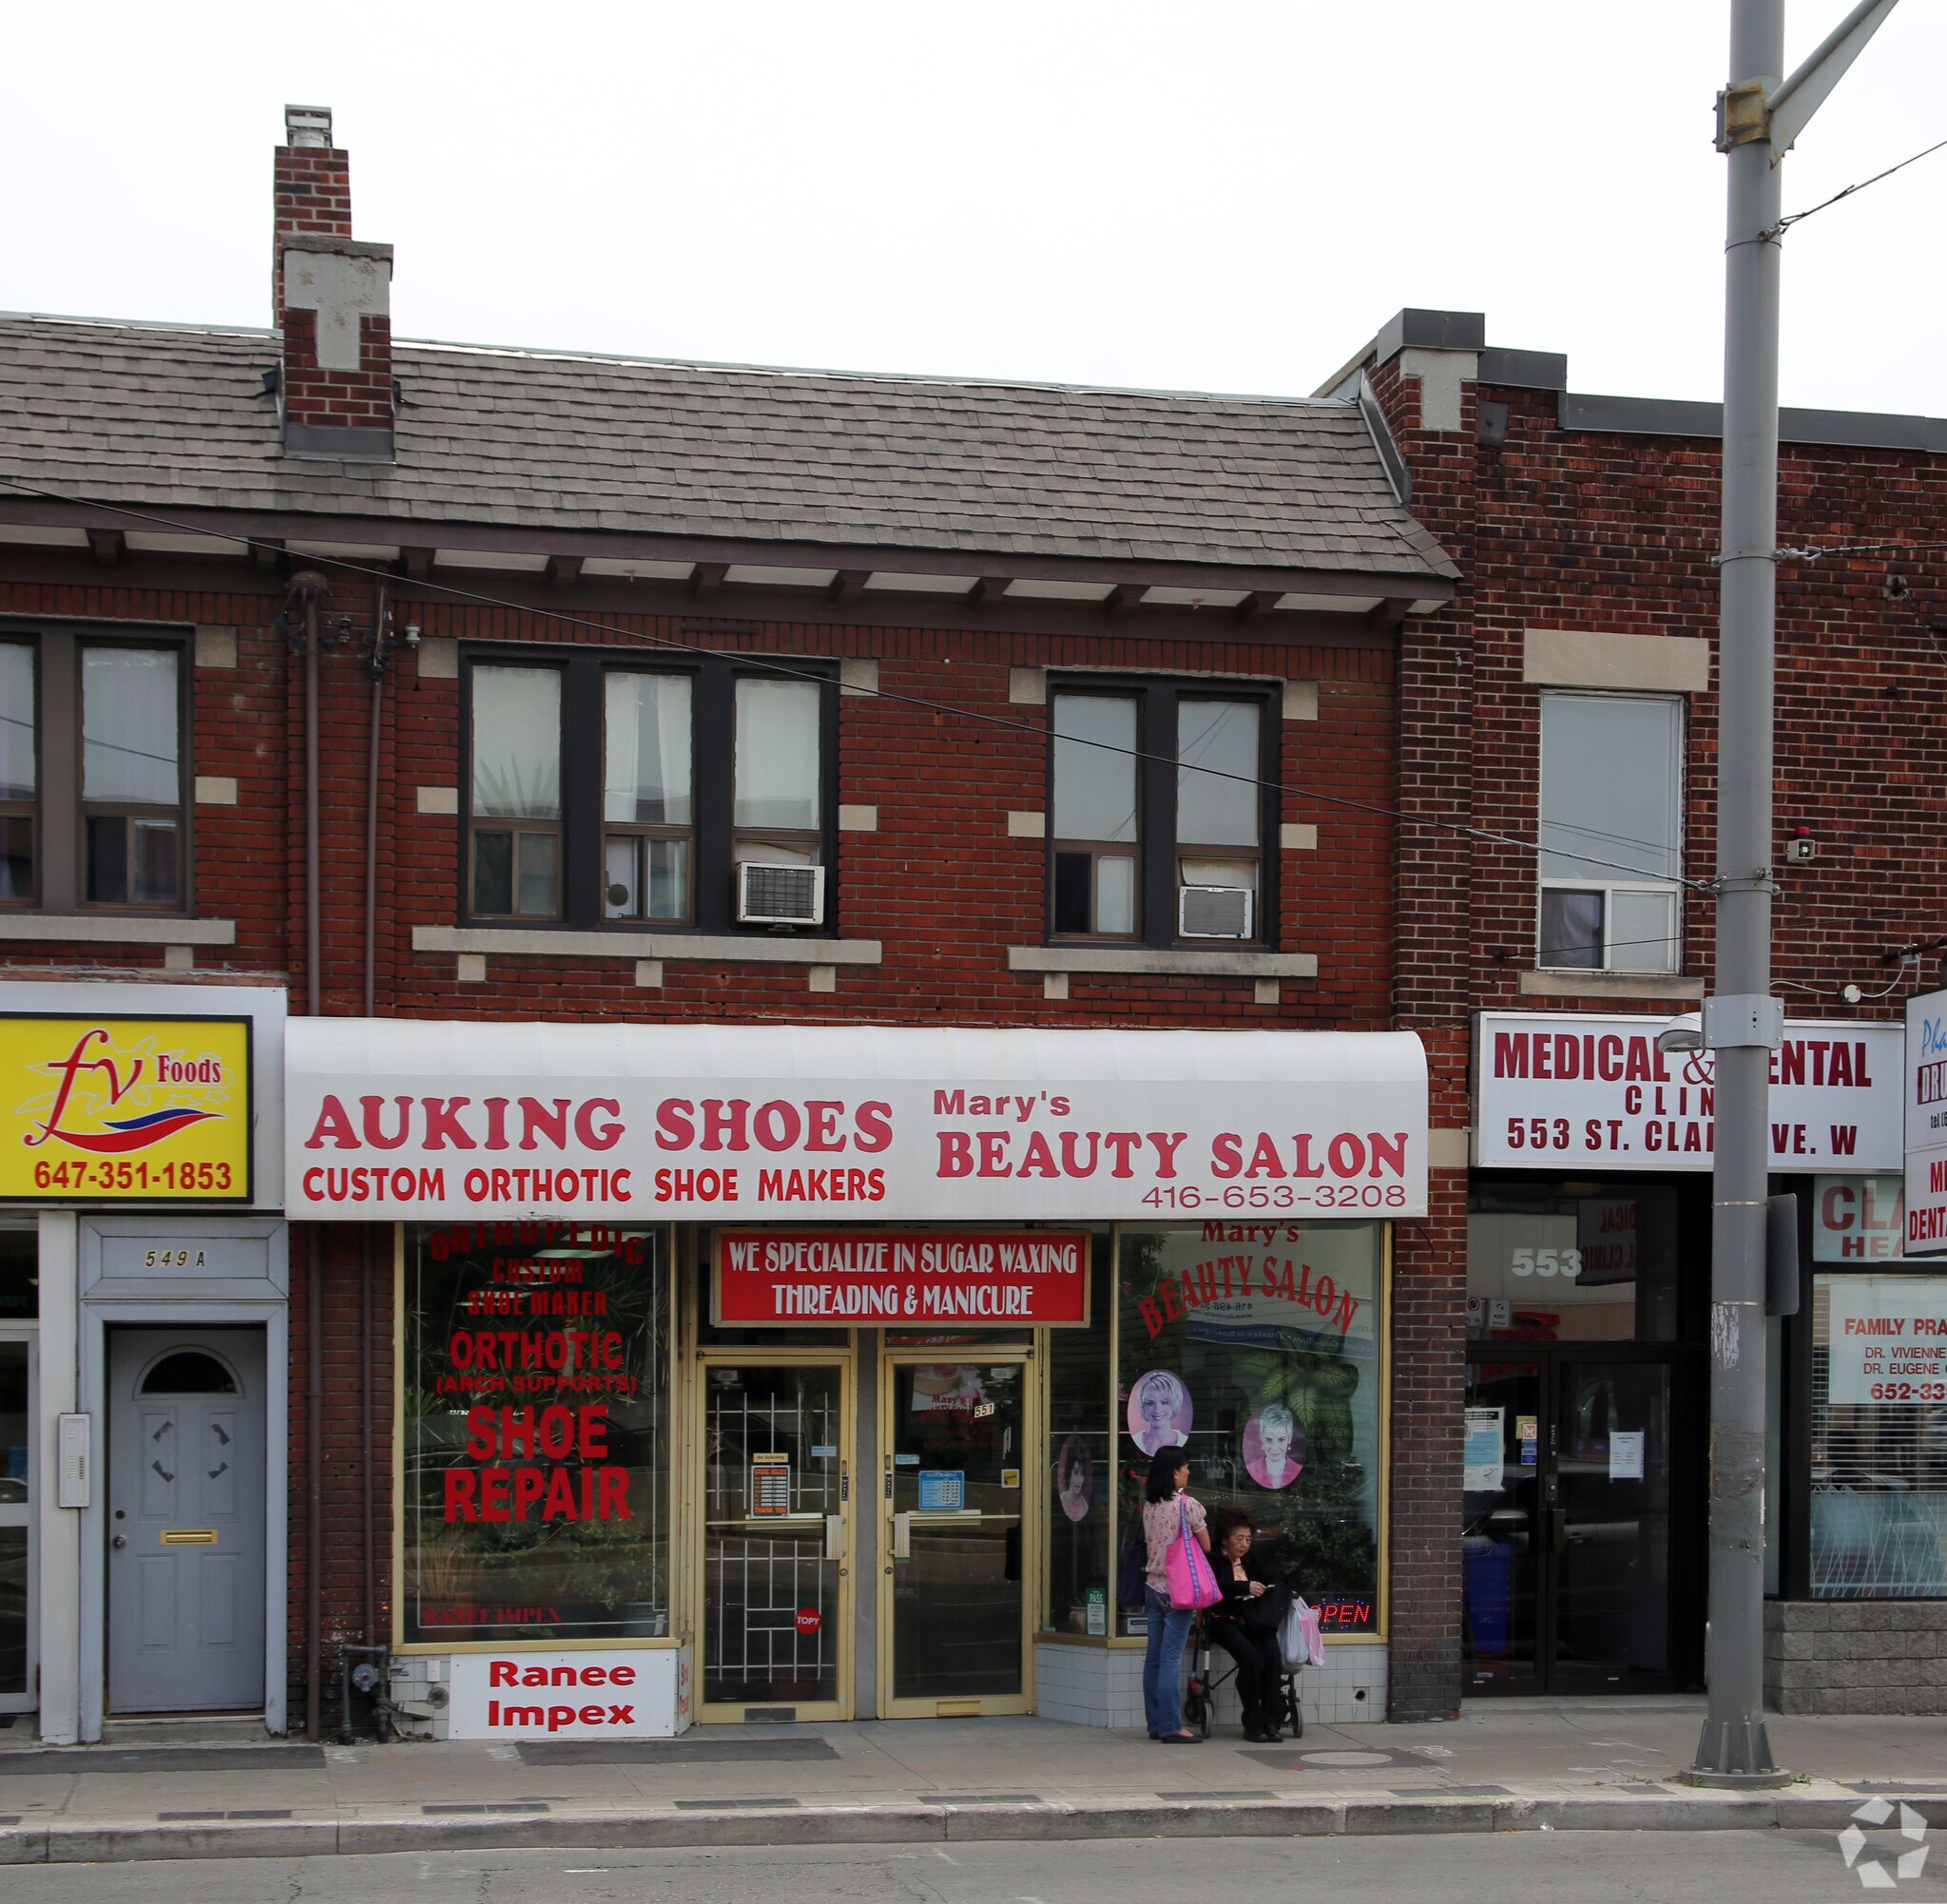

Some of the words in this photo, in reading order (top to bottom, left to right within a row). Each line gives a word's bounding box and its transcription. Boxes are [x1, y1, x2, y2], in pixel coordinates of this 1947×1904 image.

[158, 1055, 221, 1083] Foods
[1494, 1032, 1670, 1083] MEDICAL
[1768, 1040, 1872, 1087] ENTAL
[934, 1089, 1071, 1123] Mary's
[1625, 1085, 1714, 1117] CLIN
[304, 1094, 626, 1151] AUKING
[655, 1098, 894, 1153] SHOES
[1508, 1118, 1570, 1149] 553
[1586, 1120, 1629, 1151] ST.
[1645, 1120, 1714, 1152] CLAI
[1771, 1124, 1816, 1155] VE.
[1830, 1125, 1858, 1155] W
[935, 1131, 1187, 1179] BEAUTY
[1210, 1132, 1409, 1179] SALON
[34, 1161, 232, 1189] 647-351-1853
[302, 1167, 446, 1202] CUSTOM
[464, 1168, 631, 1202] ORTHOTIC
[655, 1168, 739, 1202] SHOE
[758, 1167, 885, 1202] MAKERS
[1141, 1185, 1407, 1209] 416-653-3208
[1201, 1221, 1300, 1246] Mary's
[1909, 1206, 1947, 1241] DENT
[431, 1221, 646, 1265] ORTHOPEDIC
[729, 1242, 760, 1272] WE
[765, 1242, 888, 1272] SPECIALIZE
[894, 1242, 916, 1272] IN
[921, 1243, 993, 1273] SUGAR
[999, 1243, 1077, 1274] WAXING
[146, 1251, 187, 1267] 549
[196, 1251, 204, 1267] A
[492, 1259, 583, 1282] CUSTOM
[1512, 1248, 1582, 1278] 553
[468, 1291, 523, 1316] SHOE
[530, 1291, 607, 1316] MAKER
[772, 1284, 897, 1315] THREADING
[904, 1285, 918, 1315] &
[923, 1285, 1032, 1316] MANICURE
[1138, 1256, 1253, 1339] BEAUTY
[1261, 1256, 1359, 1335] SALON
[1844, 1318, 1905, 1336] FAMILY
[1914, 1318, 1947, 1336] PRA
[450, 1331, 624, 1369] ORTHOTIC
[1865, 1347, 1885, 1358] DR.
[1891, 1347, 1946, 1358] VIVIENNE
[1863, 1363, 1883, 1375] DR.
[1889, 1363, 1939, 1375] EUGENE
[435, 1375, 504, 1395] (ARCH
[513, 1375, 637, 1395] SUPPORTS)
[1871, 1383, 1947, 1400] 652-33
[975, 1404, 993, 1416] 551
[466, 1404, 608, 1460] SHOE
[444, 1466, 632, 1523] REPAIR
[1089, 1593, 1103, 1603] PASS
[490, 1661, 636, 1687] Ranee
[489, 1700, 635, 1732] Impex
